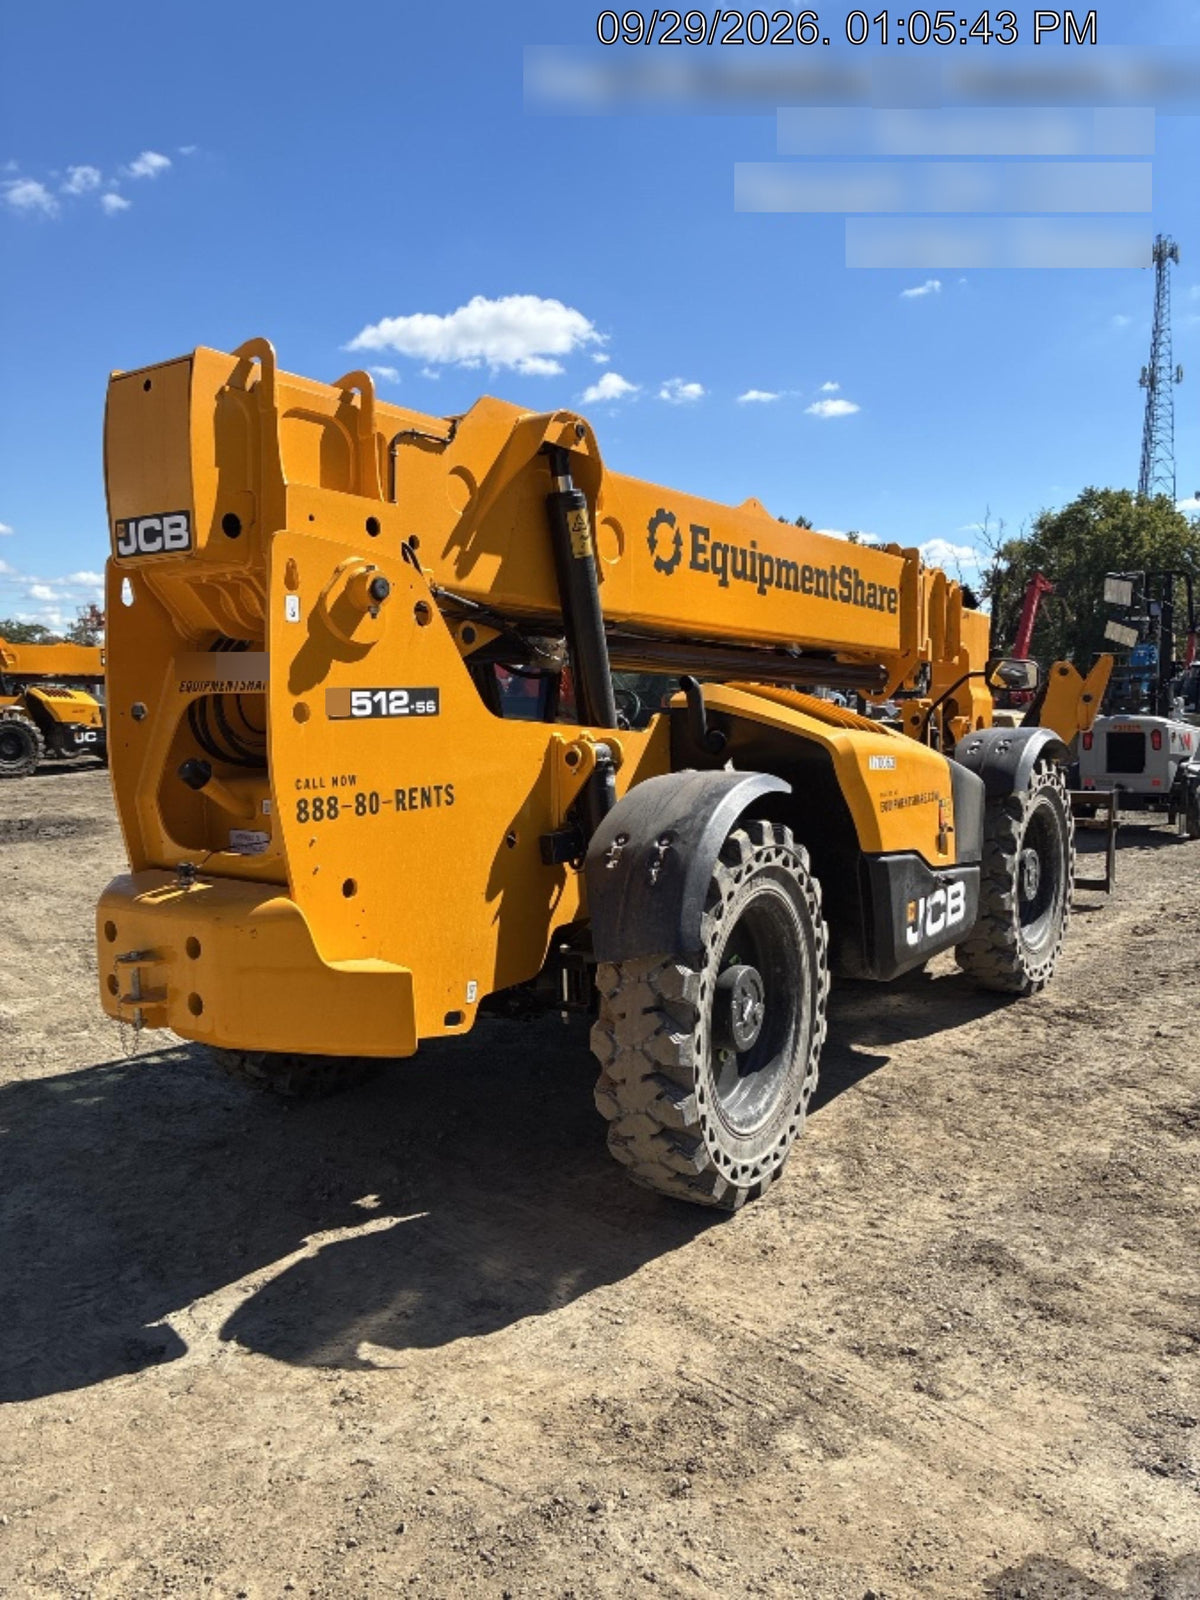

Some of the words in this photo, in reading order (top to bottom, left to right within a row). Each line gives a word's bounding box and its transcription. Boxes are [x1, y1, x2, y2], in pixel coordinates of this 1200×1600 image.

[117, 515, 189, 555] JCB
[689, 524, 898, 615] EquipmentShare
[295, 778, 325, 790] CALL
[332, 775, 357, 787] NOW
[296, 784, 455, 823] 888-80-RENTS
[906, 881, 966, 945] JCB
